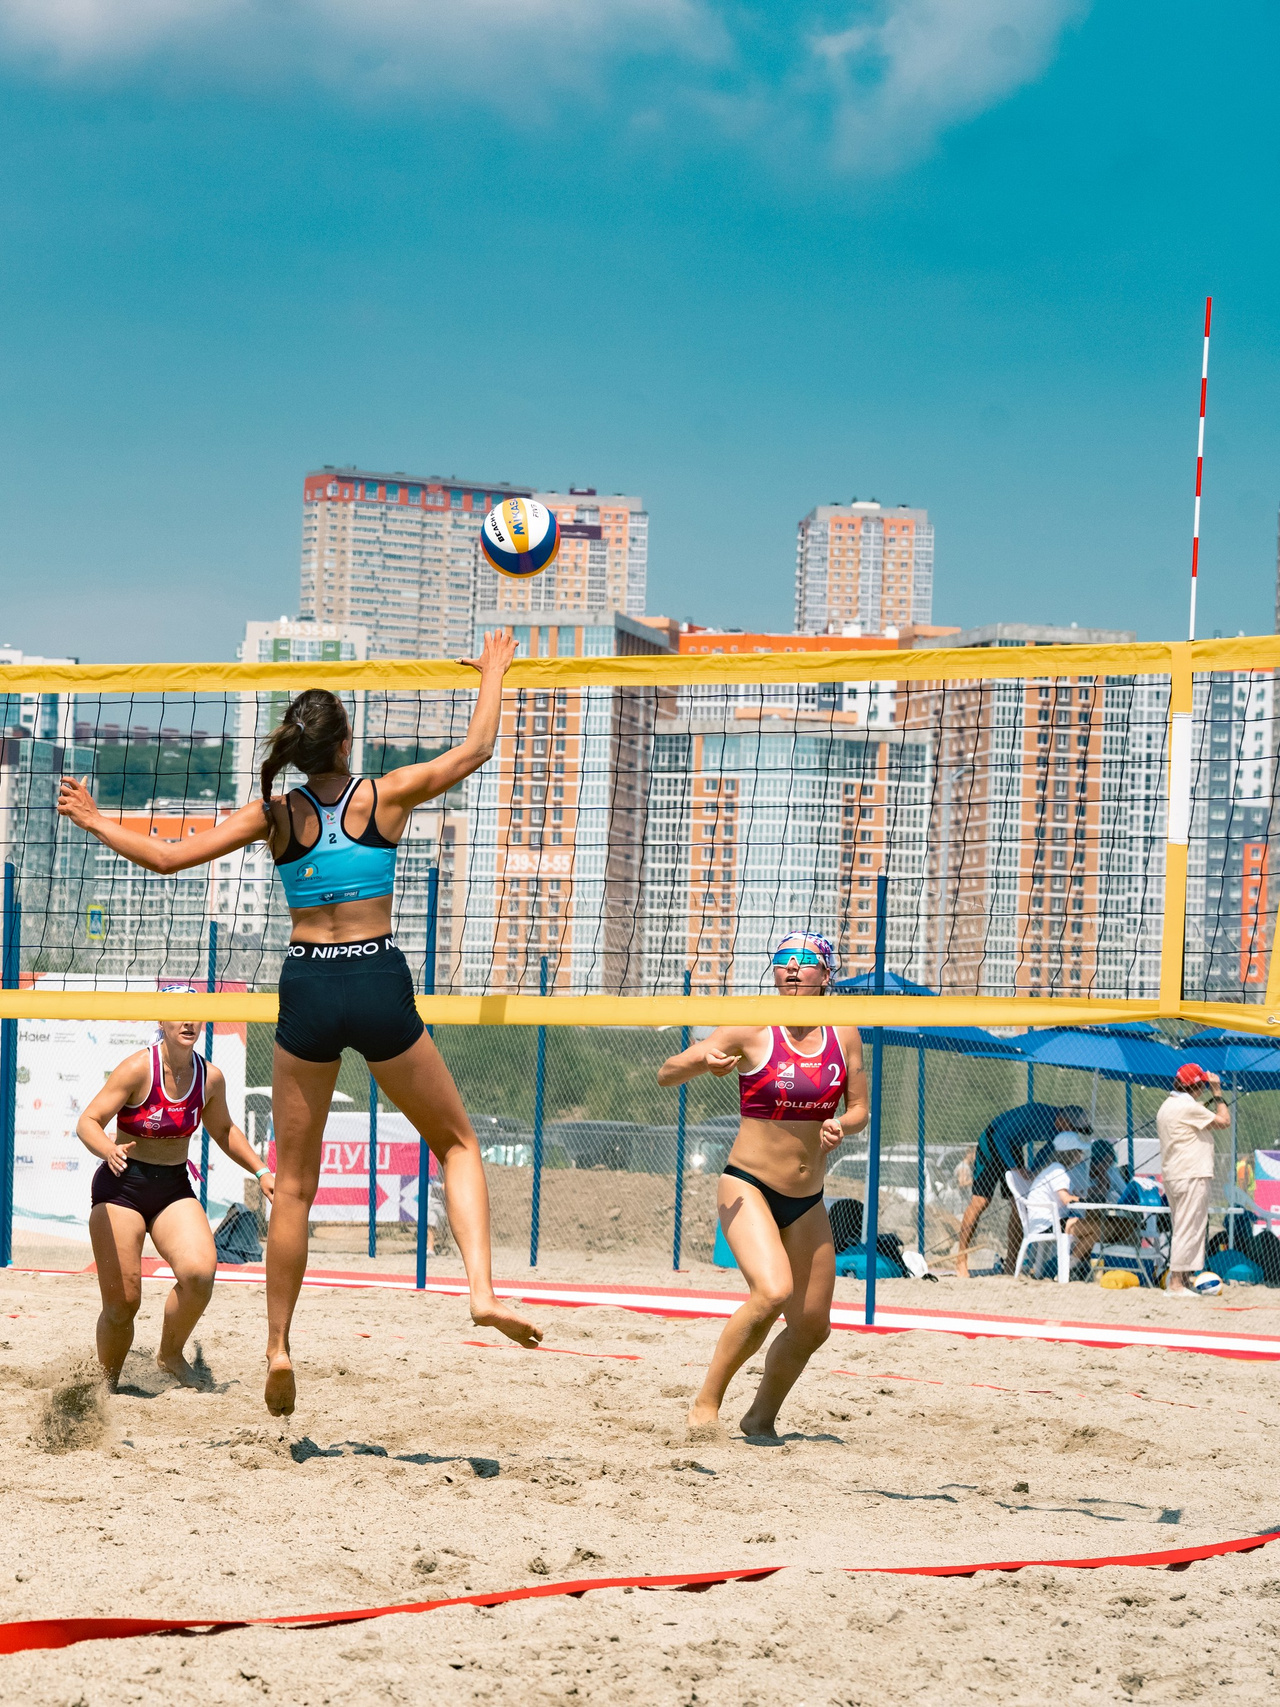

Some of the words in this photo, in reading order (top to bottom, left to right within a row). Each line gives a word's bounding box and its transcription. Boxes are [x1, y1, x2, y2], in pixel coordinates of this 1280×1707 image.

[328, 832, 337, 845] 2
[311, 942, 379, 959] NIPRO
[827, 1063, 841, 1087] 2
[774, 1099, 835, 1110] VOLLEY.RU
[191, 1106, 199, 1127] 1
[320, 1143, 391, 1174] ДУШ
